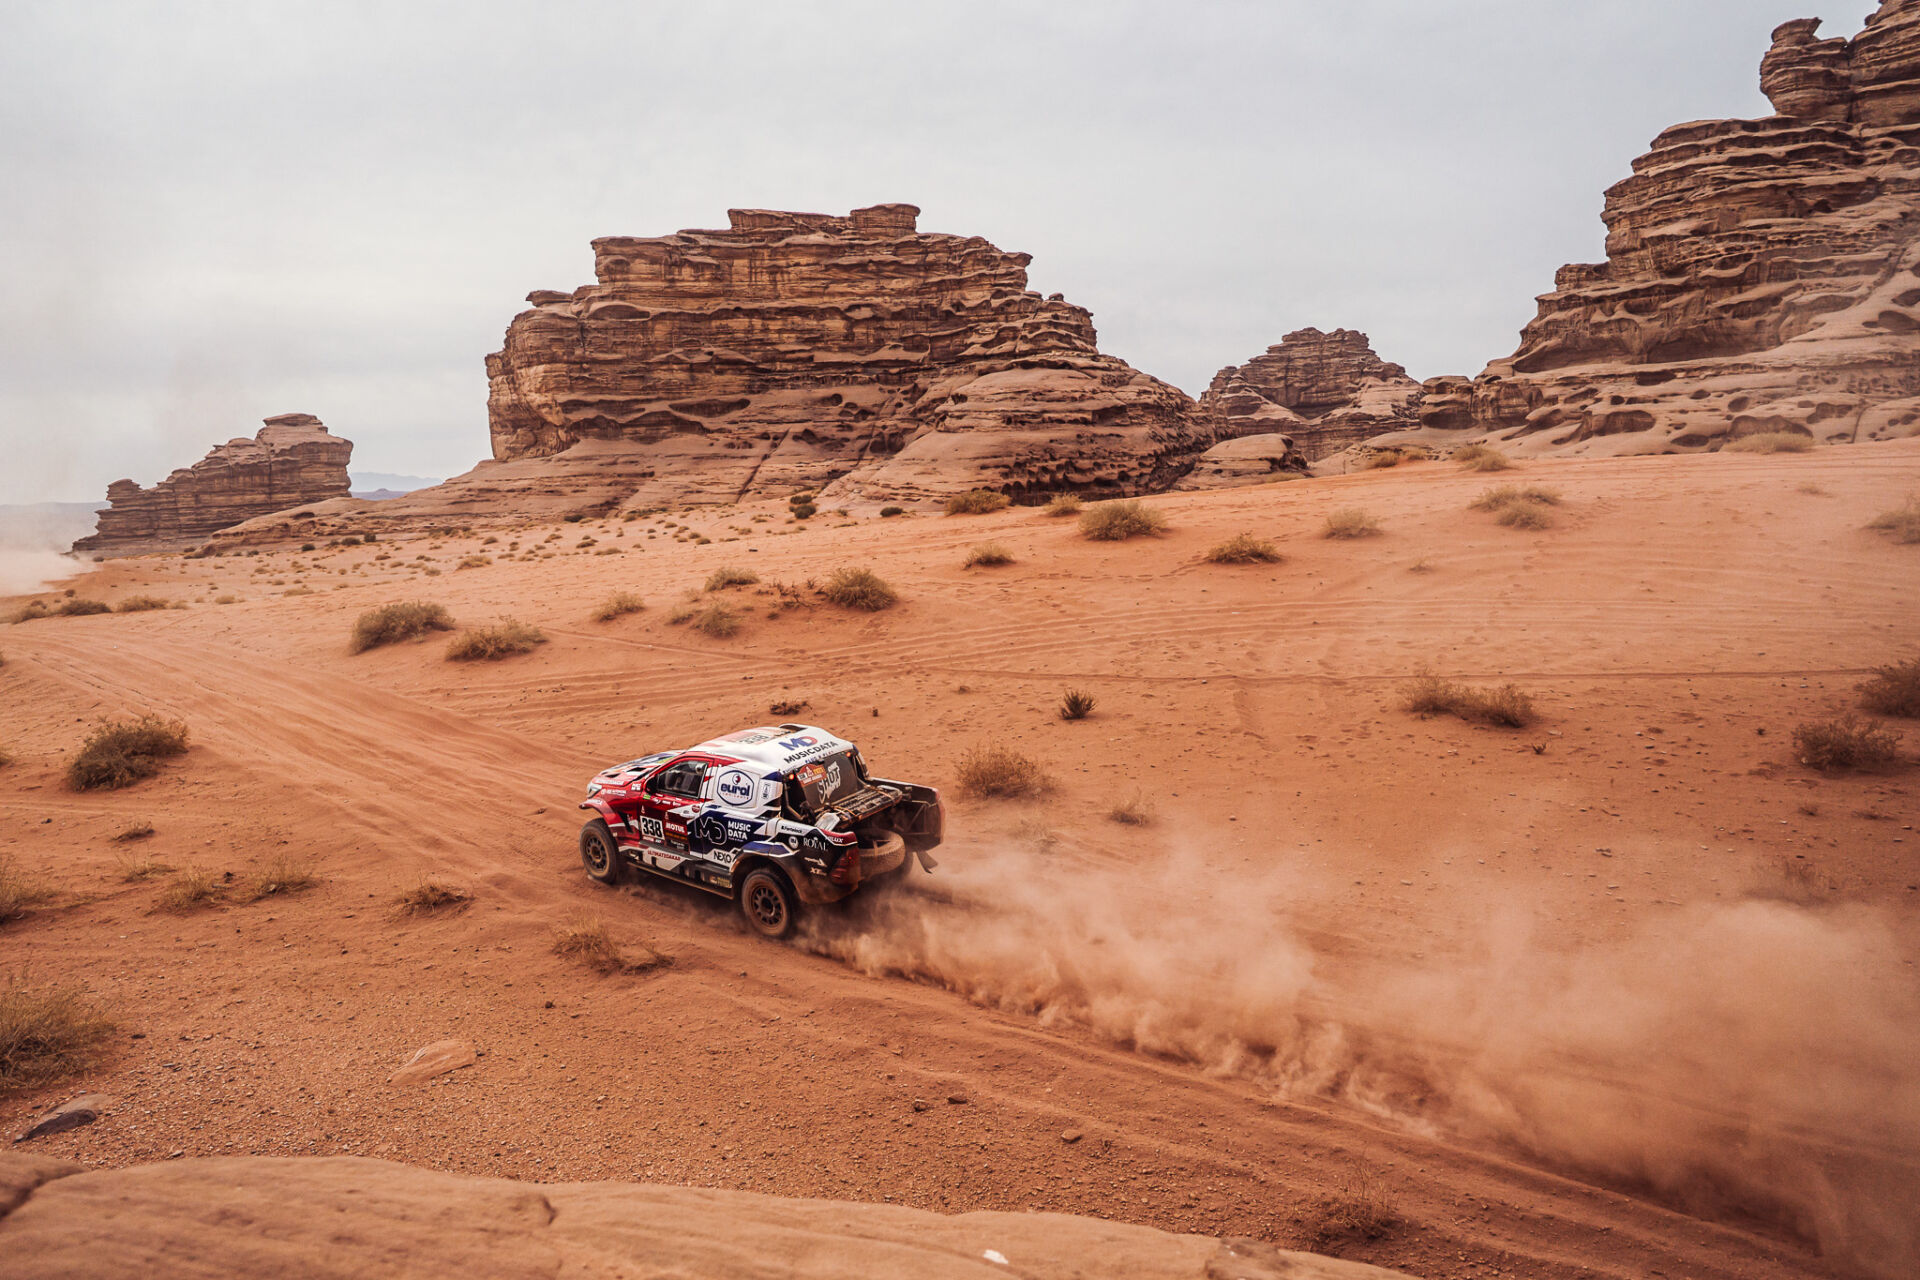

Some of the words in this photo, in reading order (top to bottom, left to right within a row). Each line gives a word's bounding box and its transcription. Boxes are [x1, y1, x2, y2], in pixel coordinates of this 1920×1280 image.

[783, 741, 838, 764] MUSICDATA
[721, 783, 750, 796] eurol
[642, 817, 662, 838] 338
[665, 821, 685, 833] MOTUL
[727, 820, 751, 832] MUSIC
[728, 830, 748, 840] DATA
[803, 836, 826, 851] ROYAL
[713, 848, 732, 863] NEXO
